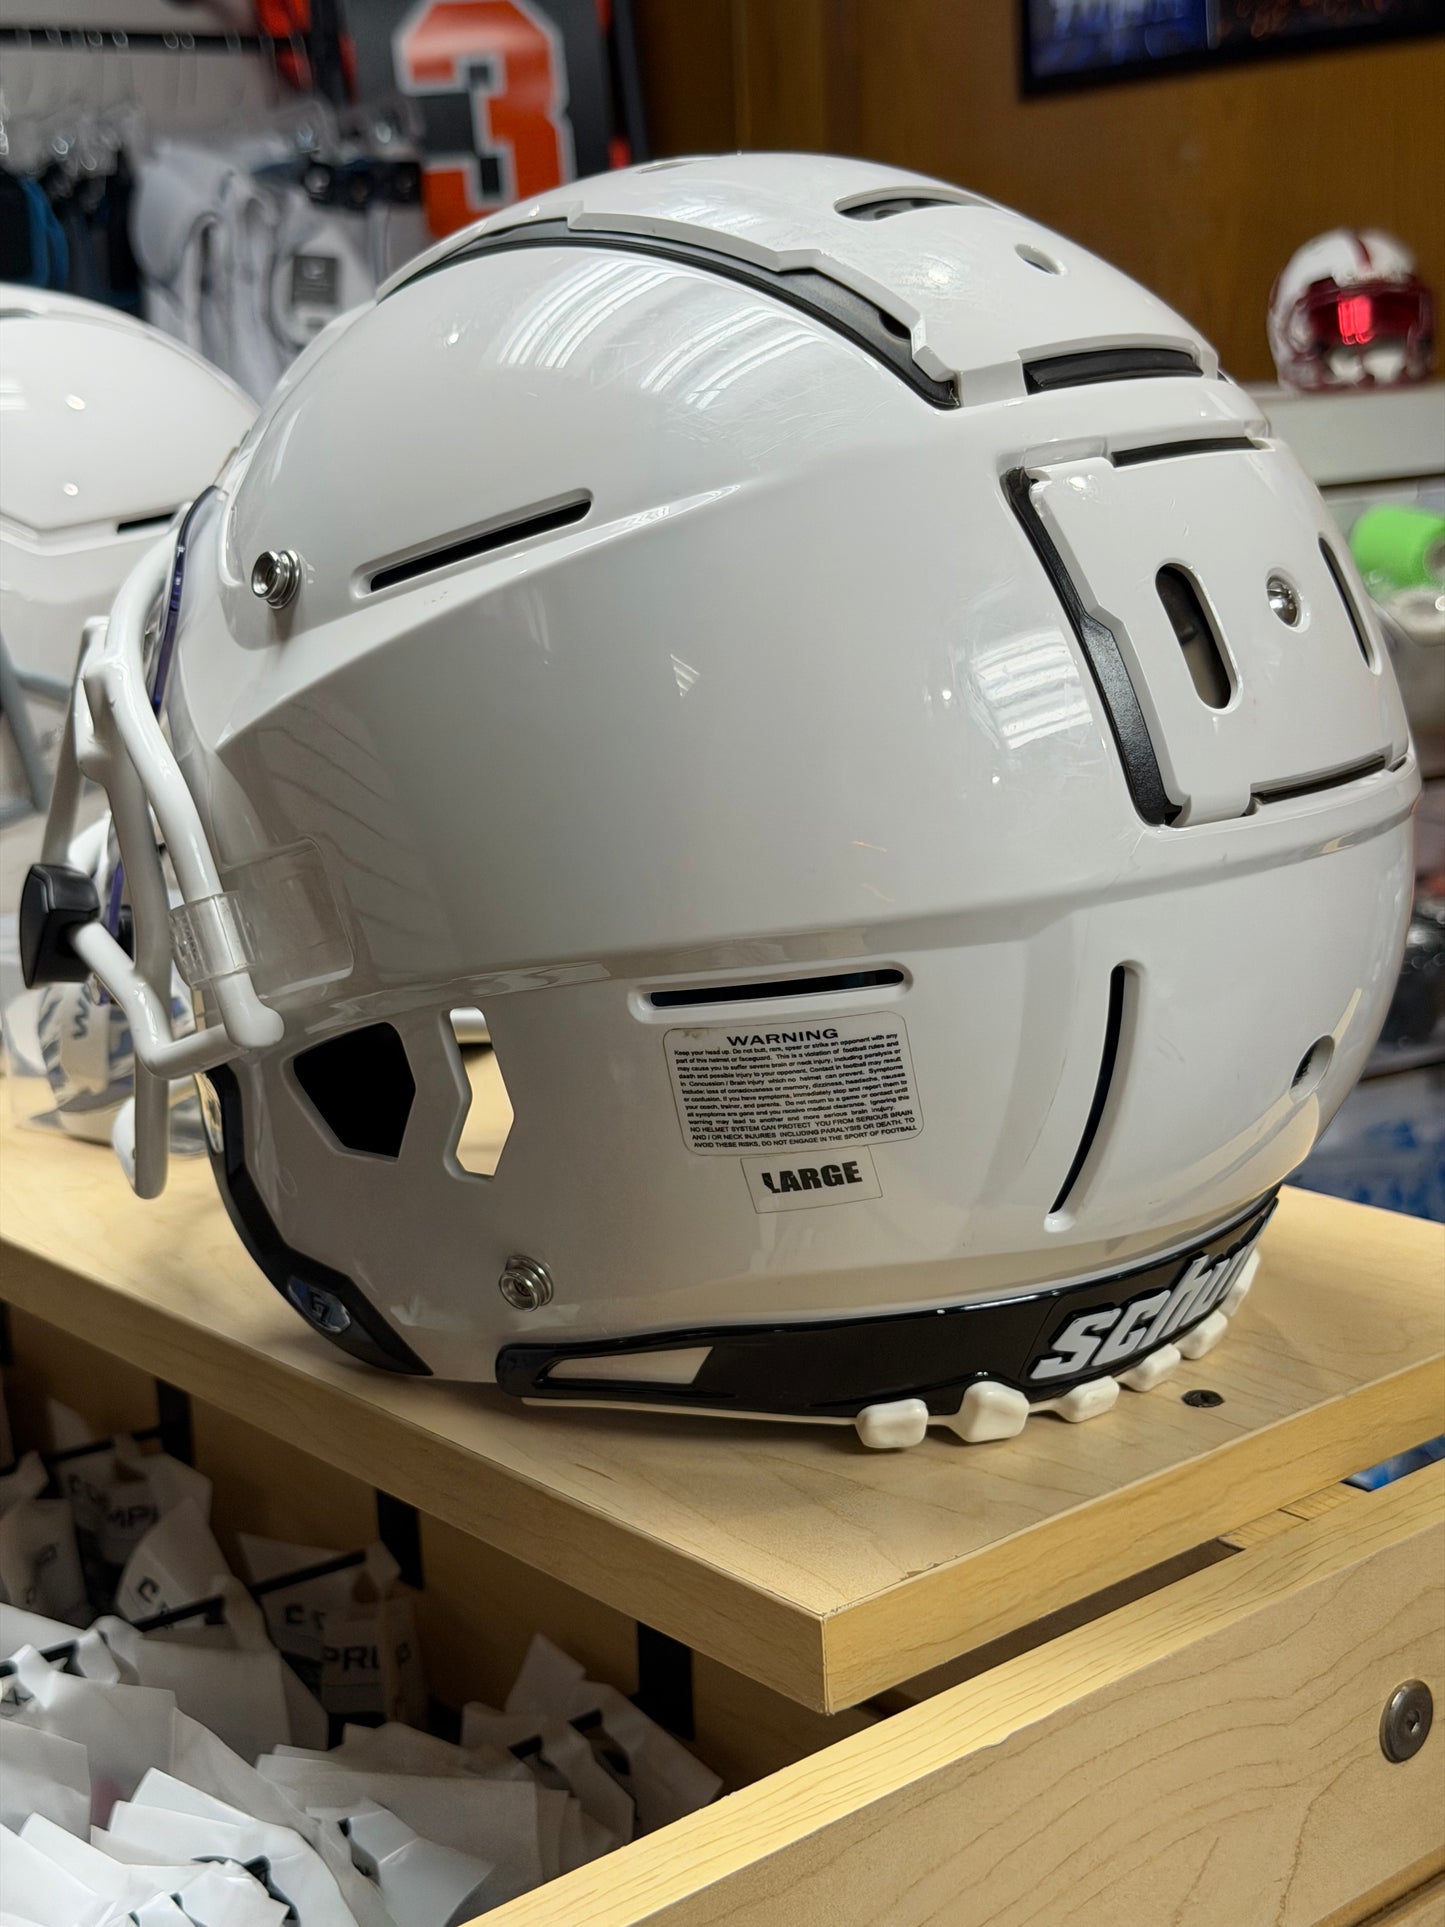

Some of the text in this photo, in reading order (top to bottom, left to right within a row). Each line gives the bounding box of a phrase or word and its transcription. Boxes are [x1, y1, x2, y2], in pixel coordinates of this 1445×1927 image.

[391, 0, 578, 240] 3
[727, 1028, 839, 1046] WARNING
[840, 1037, 870, 1045] opponent
[834, 1054, 862, 1062] including
[864, 1050, 892, 1059] paralysis
[869, 1065, 903, 1074] Symptoms
[856, 1112, 888, 1122] SERIOUS
[780, 1127, 819, 1137] INCLUDING
[821, 1125, 861, 1134] PARALYSIS
[844, 1132, 868, 1140] SPORT
[881, 1125, 917, 1135] FOOTBALL
[761, 1161, 863, 1193] LARGE
